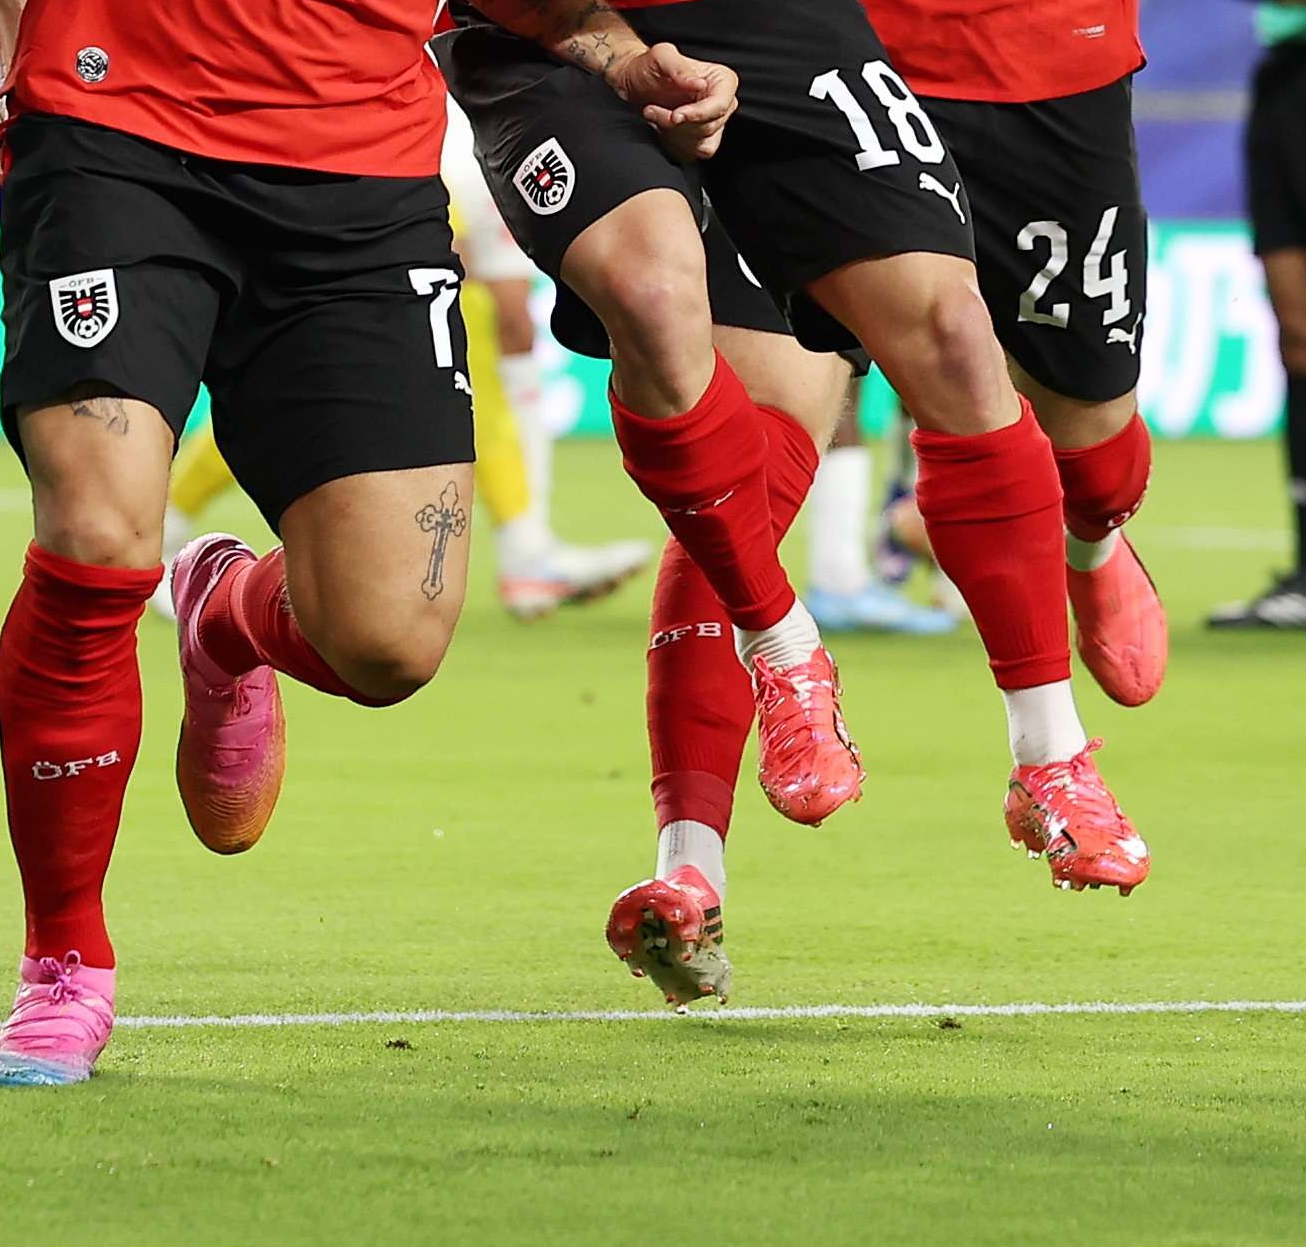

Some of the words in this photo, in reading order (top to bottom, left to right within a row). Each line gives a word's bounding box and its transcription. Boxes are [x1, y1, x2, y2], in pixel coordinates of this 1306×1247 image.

[808, 60, 945, 171] 18
[1016, 206, 1128, 329] 24
[31, 749, 121, 781] ÖFB
